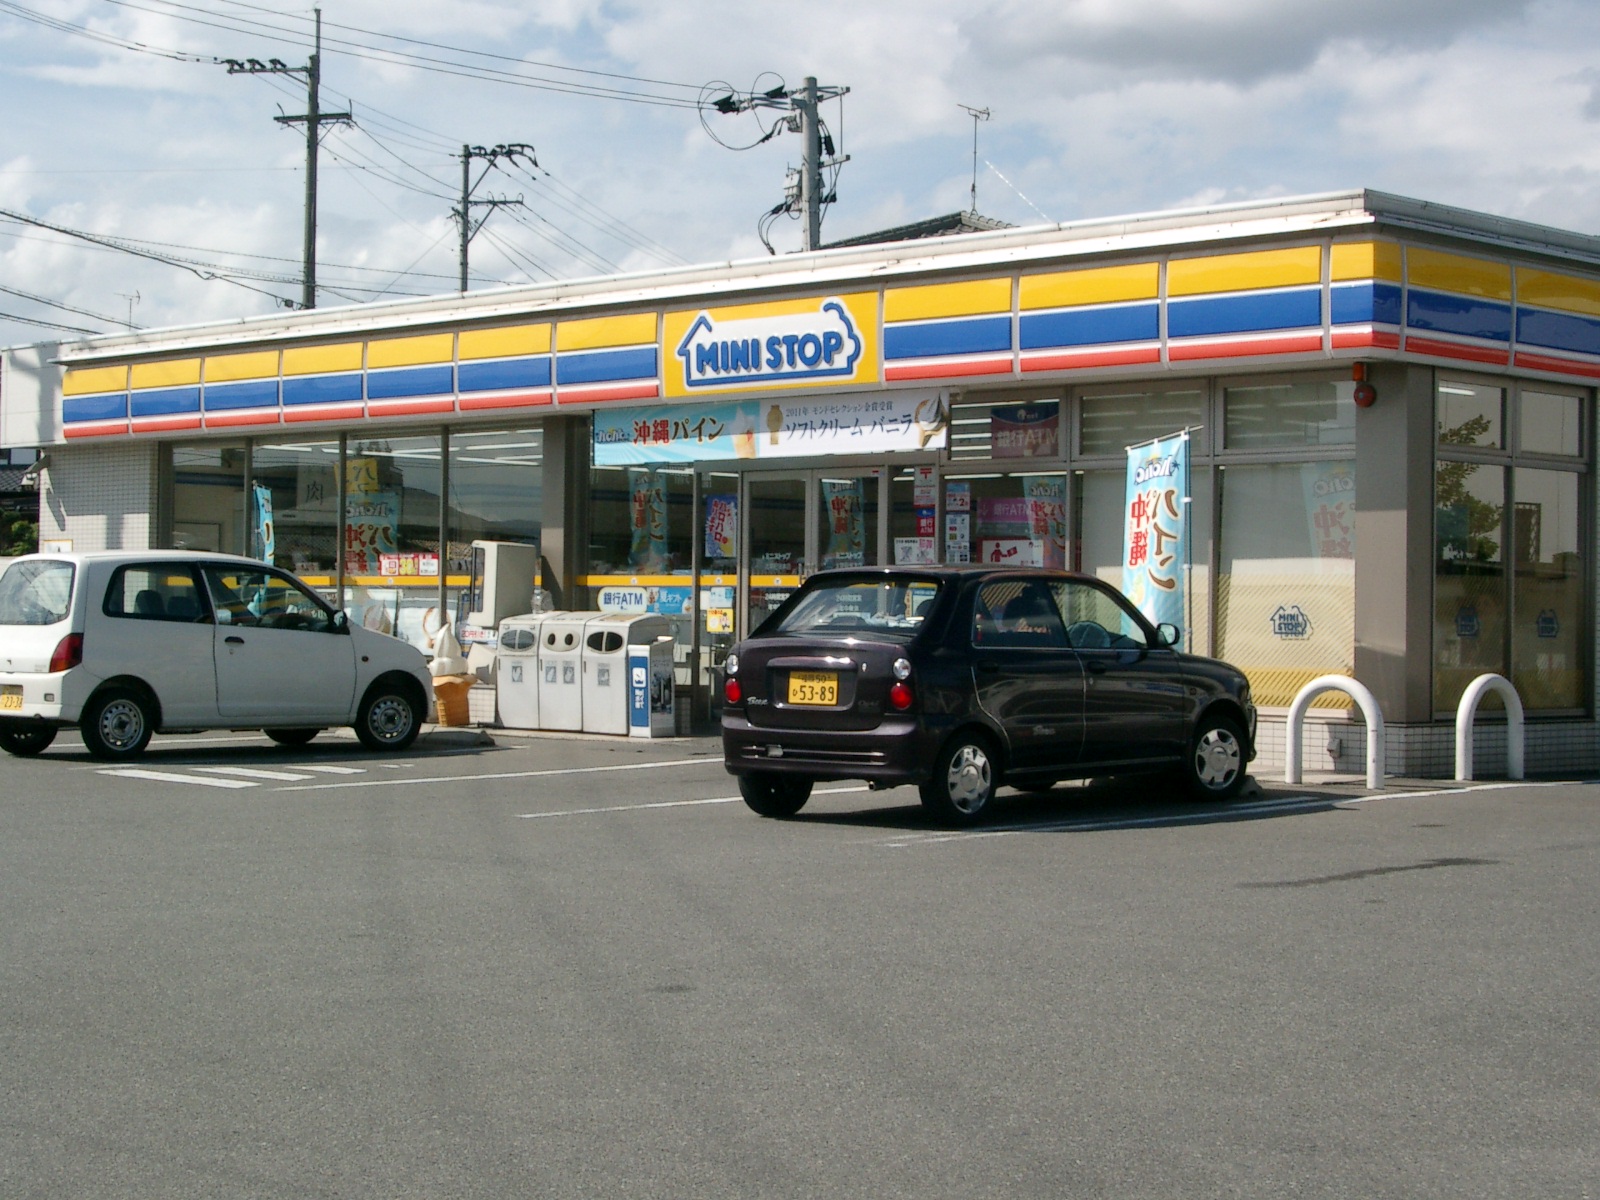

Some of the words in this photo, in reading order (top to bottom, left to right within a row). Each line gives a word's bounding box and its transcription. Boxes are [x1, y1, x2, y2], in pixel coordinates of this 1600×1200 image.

[696, 338, 761, 374] MINI
[766, 331, 844, 369] STOP
[633, 417, 724, 444] 沖縄パイン
[786, 417, 863, 440] ソフトクリーム
[870, 413, 913, 436] バニラ
[603, 592, 643, 605] 銀行ATM
[799, 685, 834, 701] 53-89
